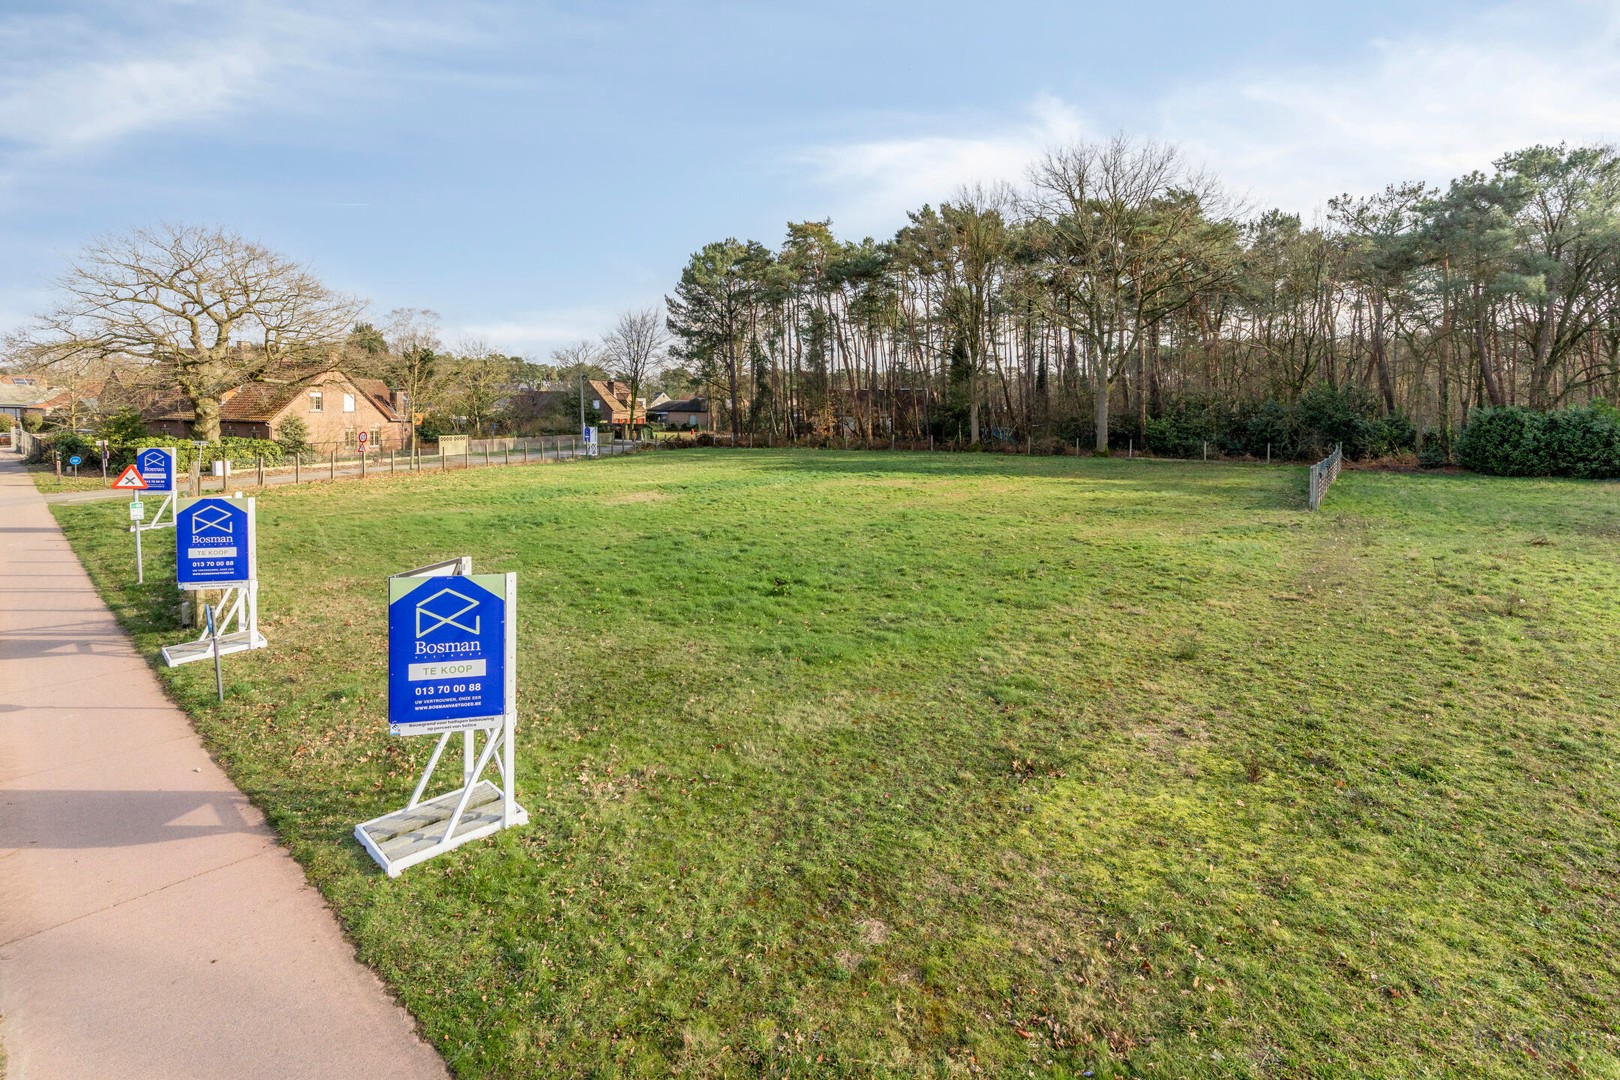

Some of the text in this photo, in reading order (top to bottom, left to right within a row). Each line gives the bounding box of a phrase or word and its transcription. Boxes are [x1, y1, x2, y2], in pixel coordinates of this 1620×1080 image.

[192, 535, 233, 544] Bosman
[415, 640, 481, 654] Bosman
[422, 664, 473, 676] TE KOOP
[415, 683, 481, 696] 013 70 00 88
[414, 701, 482, 711] WWW.BOSMANVASTGOED.BE
